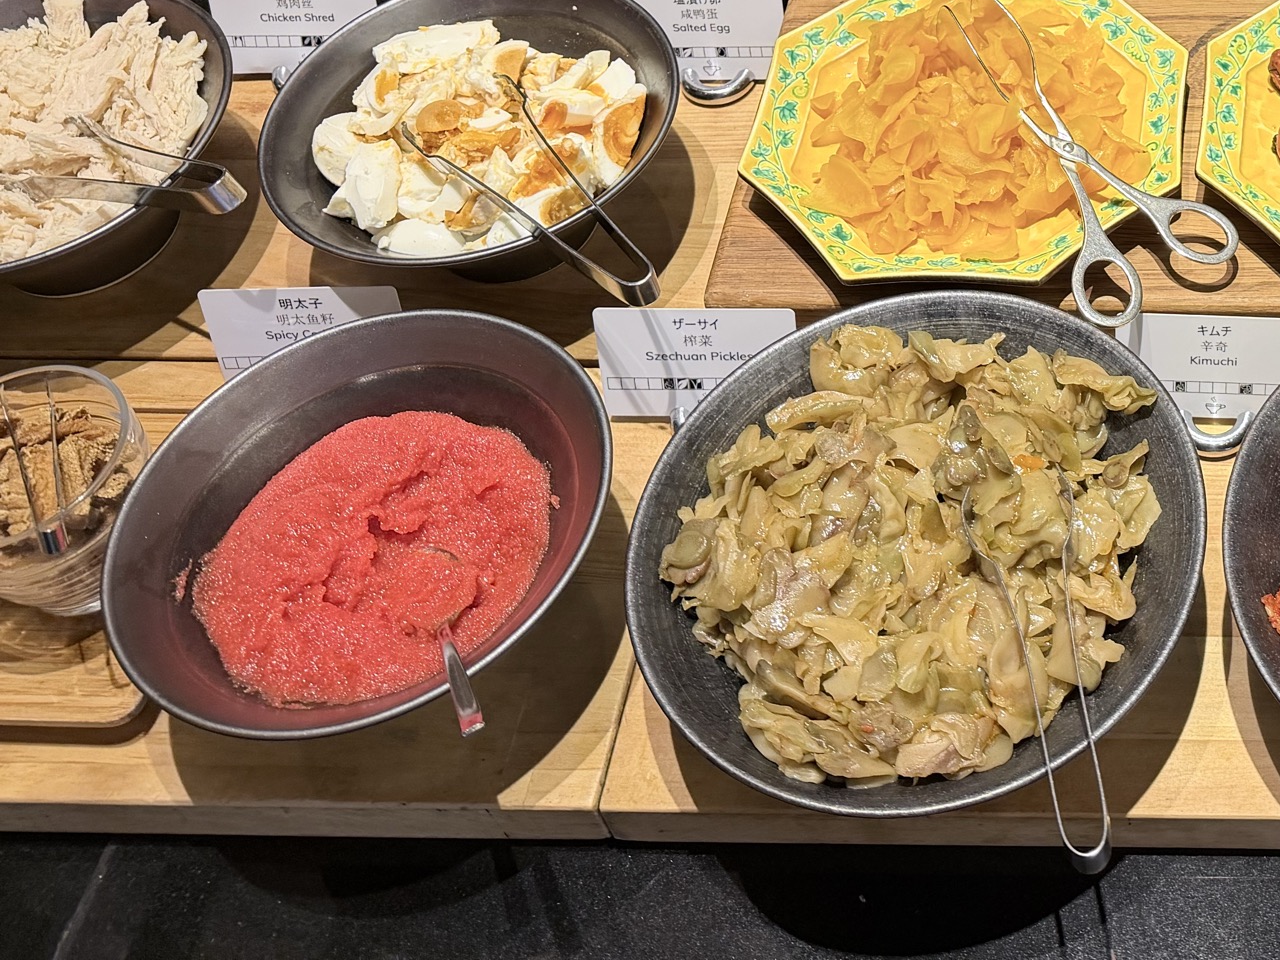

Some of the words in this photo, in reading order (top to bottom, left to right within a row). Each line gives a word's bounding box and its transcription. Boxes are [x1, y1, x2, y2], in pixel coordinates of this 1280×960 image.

[260, 13, 302, 23] Chicken
[304, 12, 335, 22] Shred
[672, 23, 707, 33] Salted
[710, 23, 731, 34] Egg
[278, 297, 322, 310] 明太子
[276, 313, 335, 326] 明太鱼籽
[672, 318, 719, 330] ザーサイ
[265, 330, 299, 342] Spicy
[1197, 325, 1232, 337] キムチ
[1201, 340, 1228, 352] 辛奇
[645, 351, 707, 362] Szechuan
[710, 351, 754, 362] Pickles
[1189, 355, 1238, 367] Kimuchi
